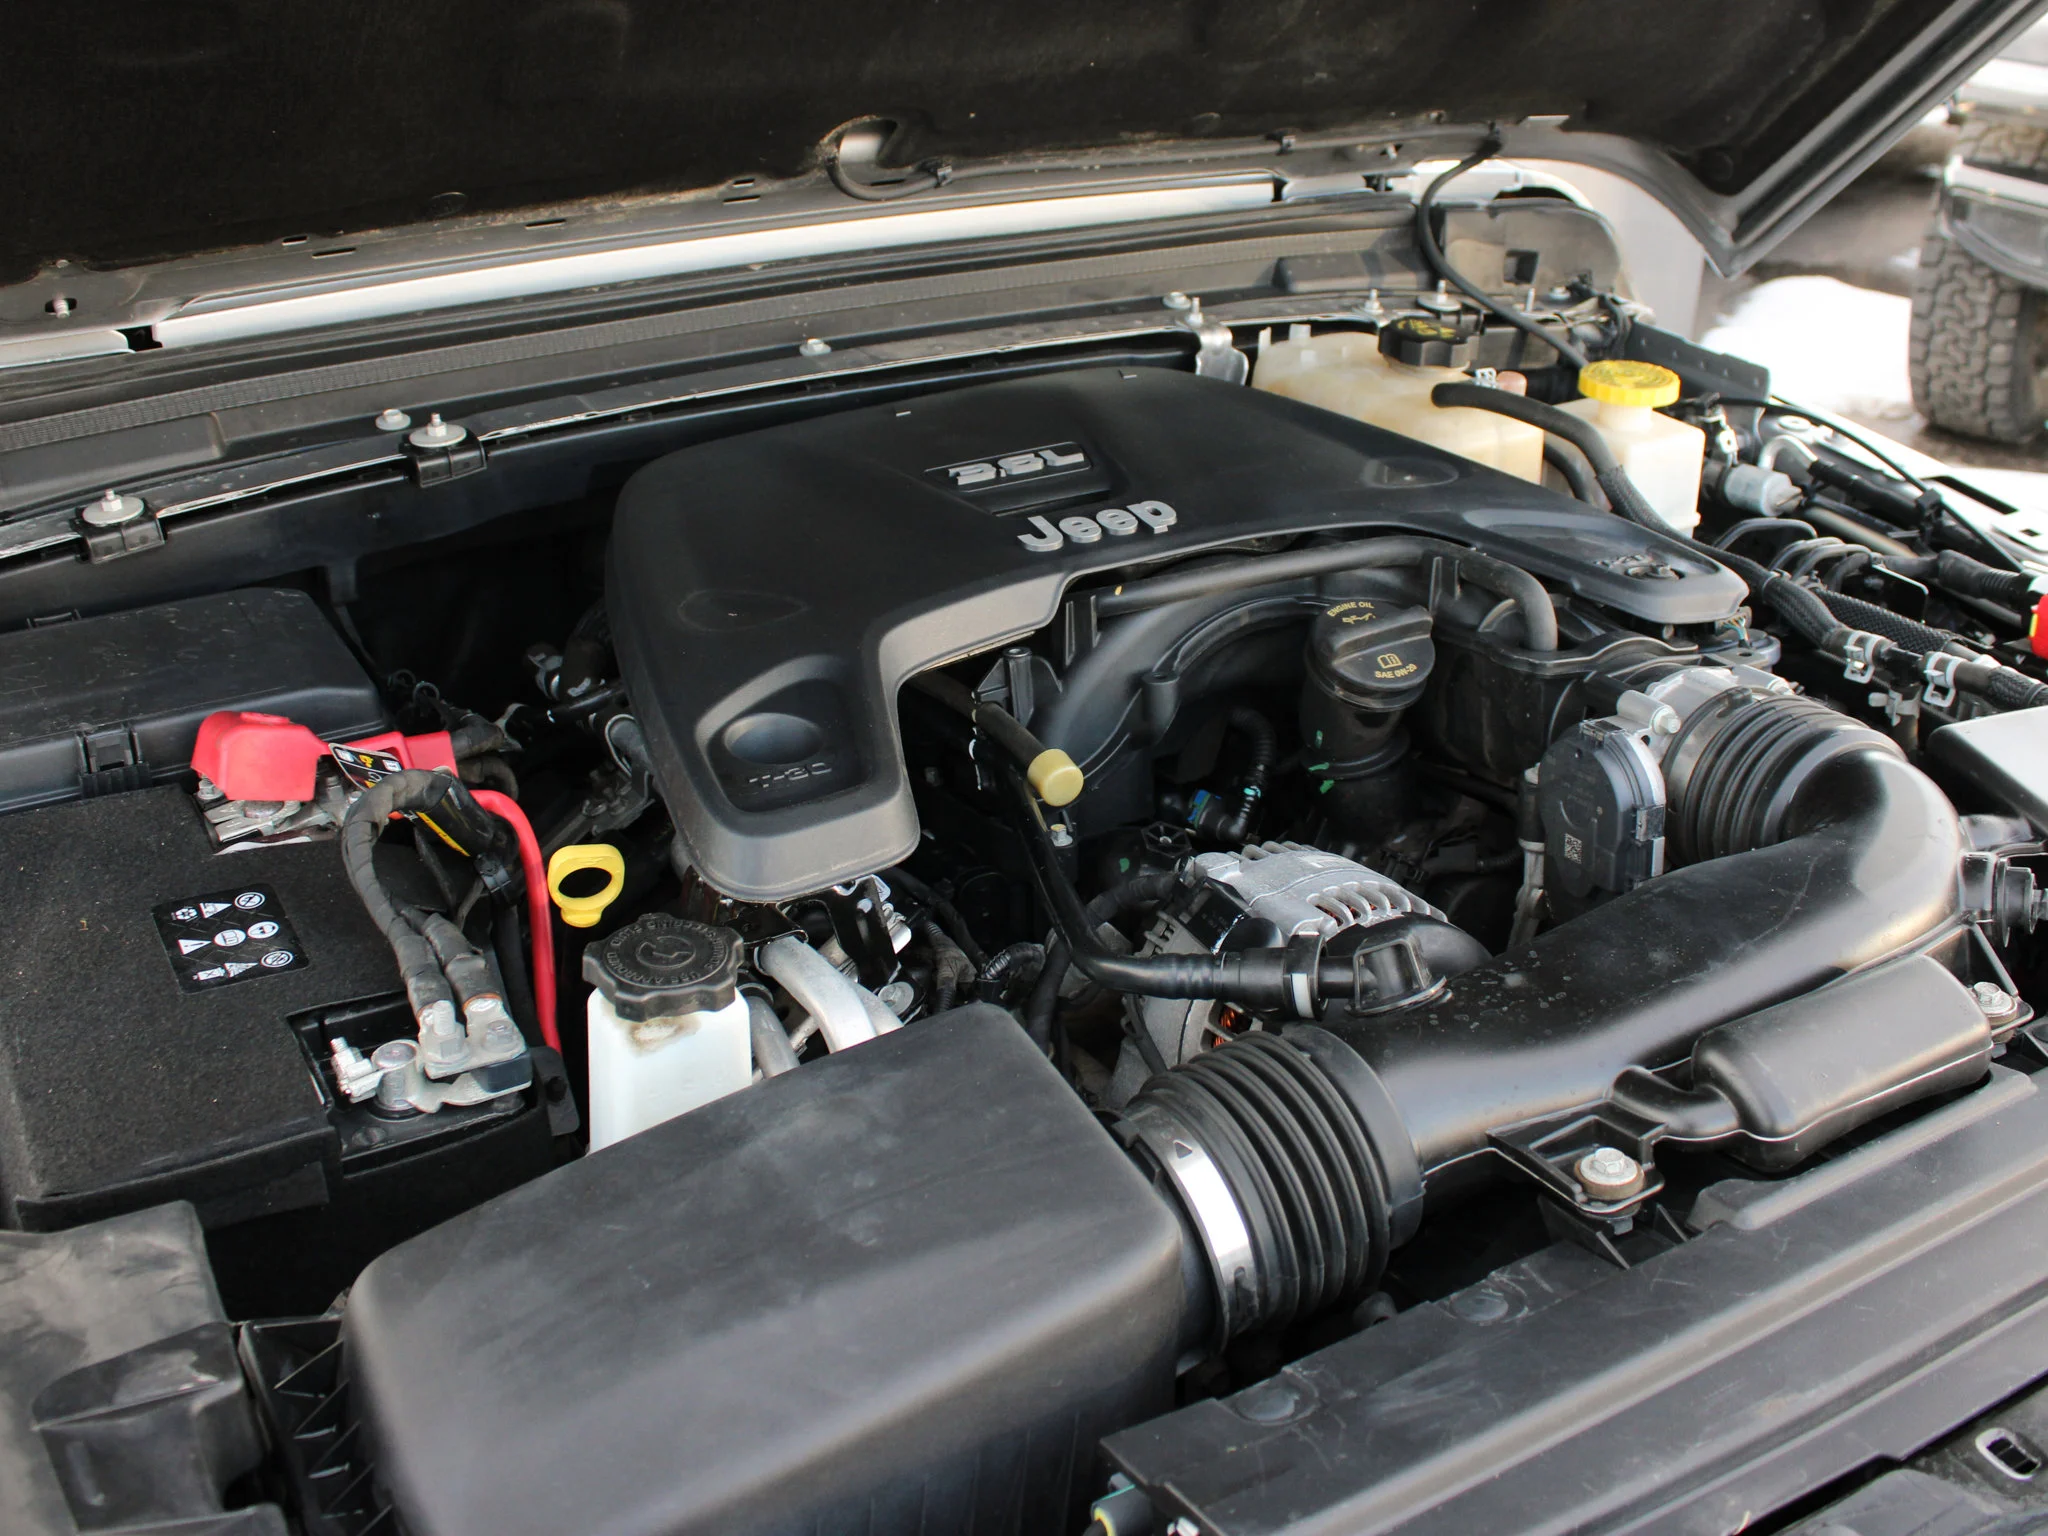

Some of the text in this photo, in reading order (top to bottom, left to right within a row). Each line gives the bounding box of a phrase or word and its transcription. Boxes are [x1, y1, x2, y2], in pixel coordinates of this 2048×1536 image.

[1017, 500, 1177, 552] Jeep
[1327, 601, 1375, 617] ENGINE OIL
[1374, 670, 1395, 679] SAE
[606, 952, 664, 985] APPROVED
